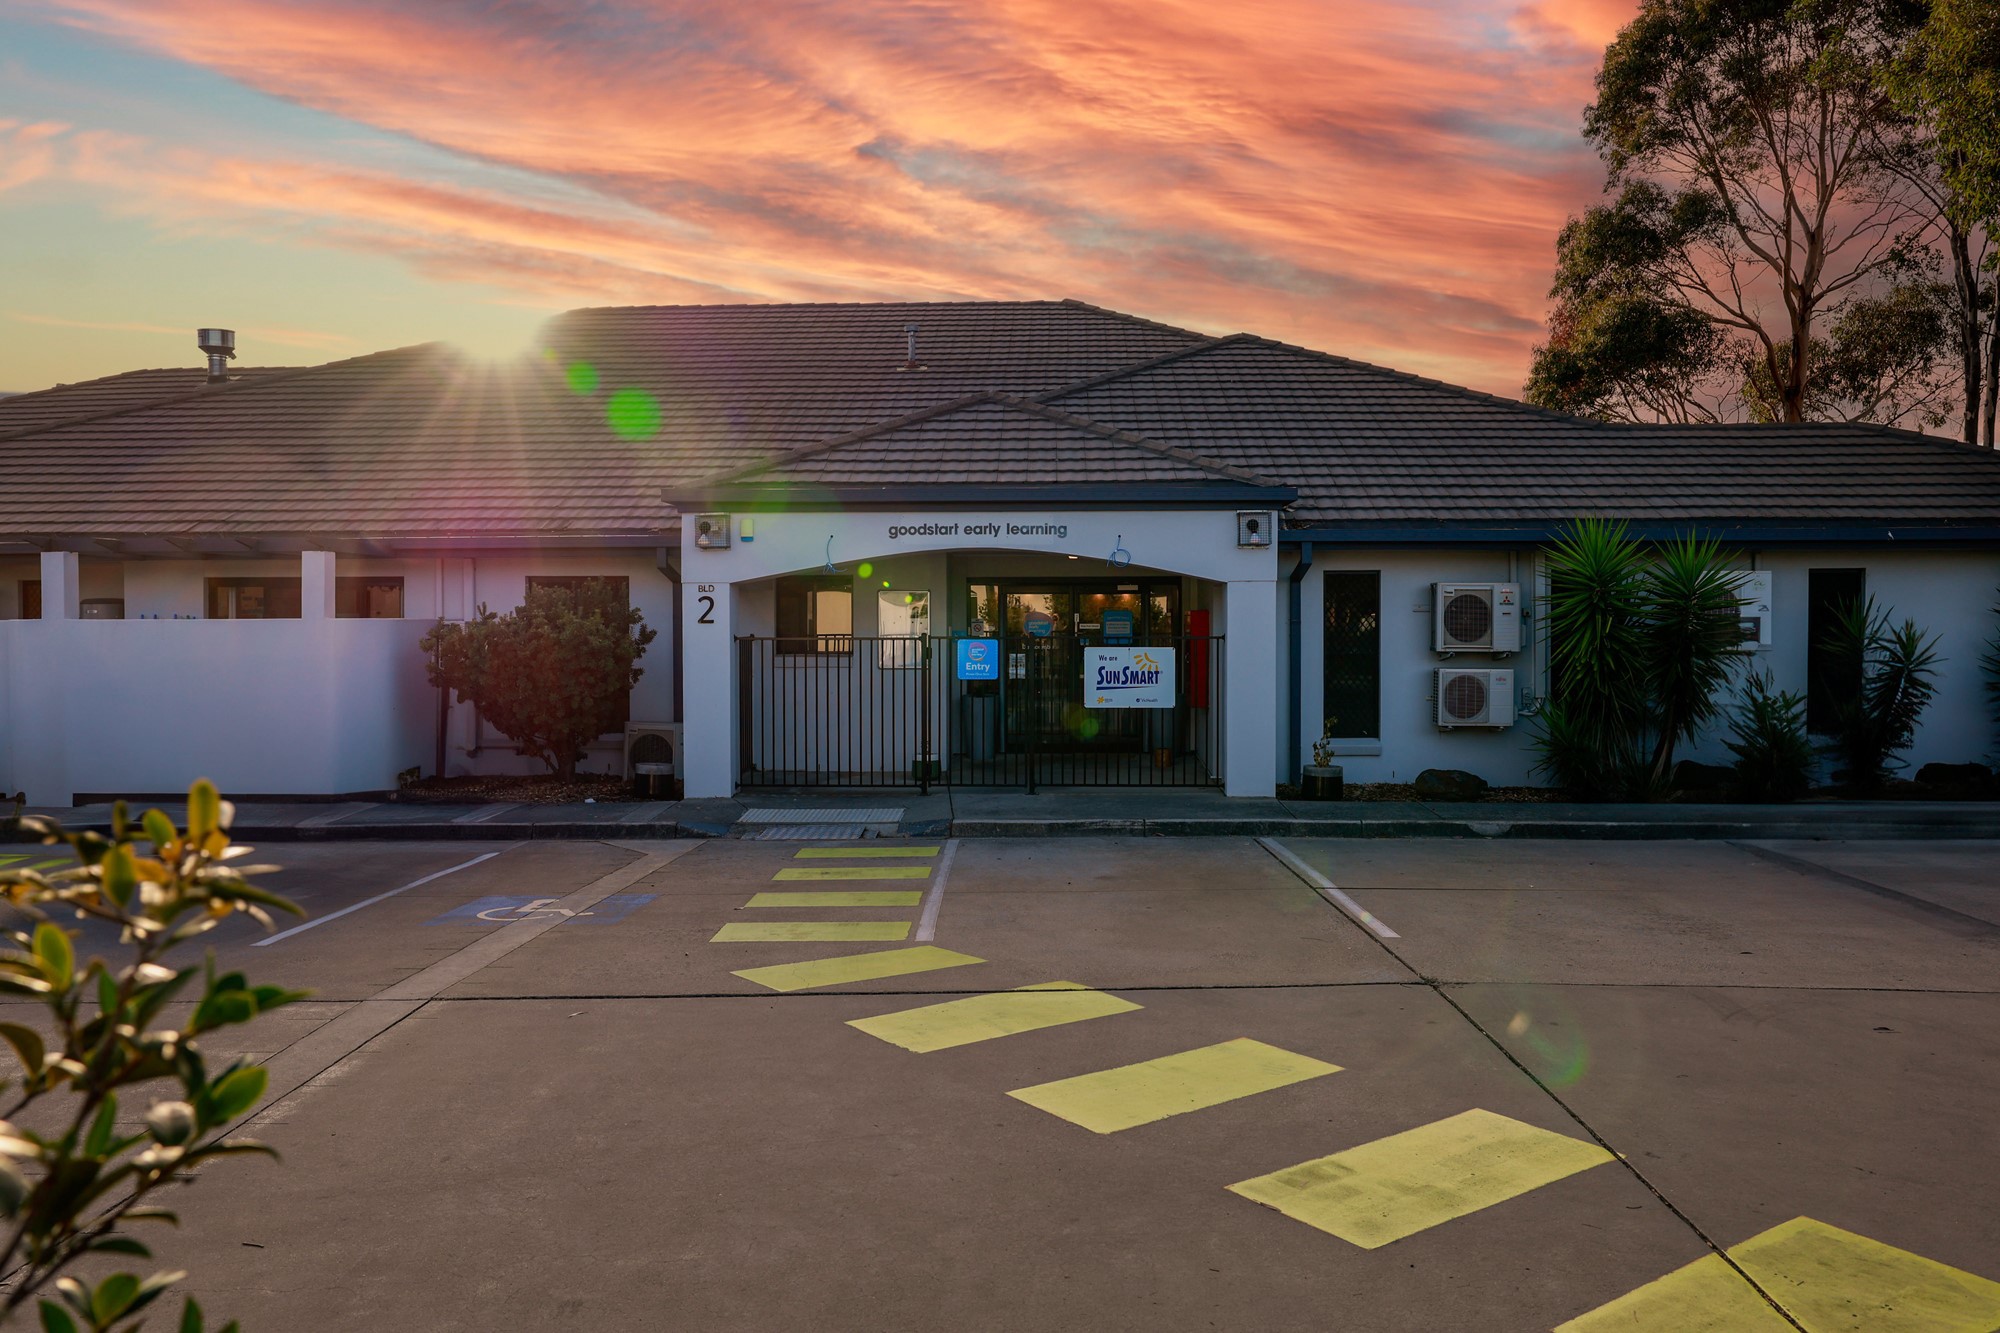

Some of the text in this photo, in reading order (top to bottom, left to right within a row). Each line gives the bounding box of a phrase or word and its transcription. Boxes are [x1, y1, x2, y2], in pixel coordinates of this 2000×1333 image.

[888, 523, 1067, 539] goodstart early learning
[698, 584, 715, 593] BLD
[697, 595, 715, 624] 2
[1098, 654, 1107, 662] We
[965, 662, 990, 673] Entry
